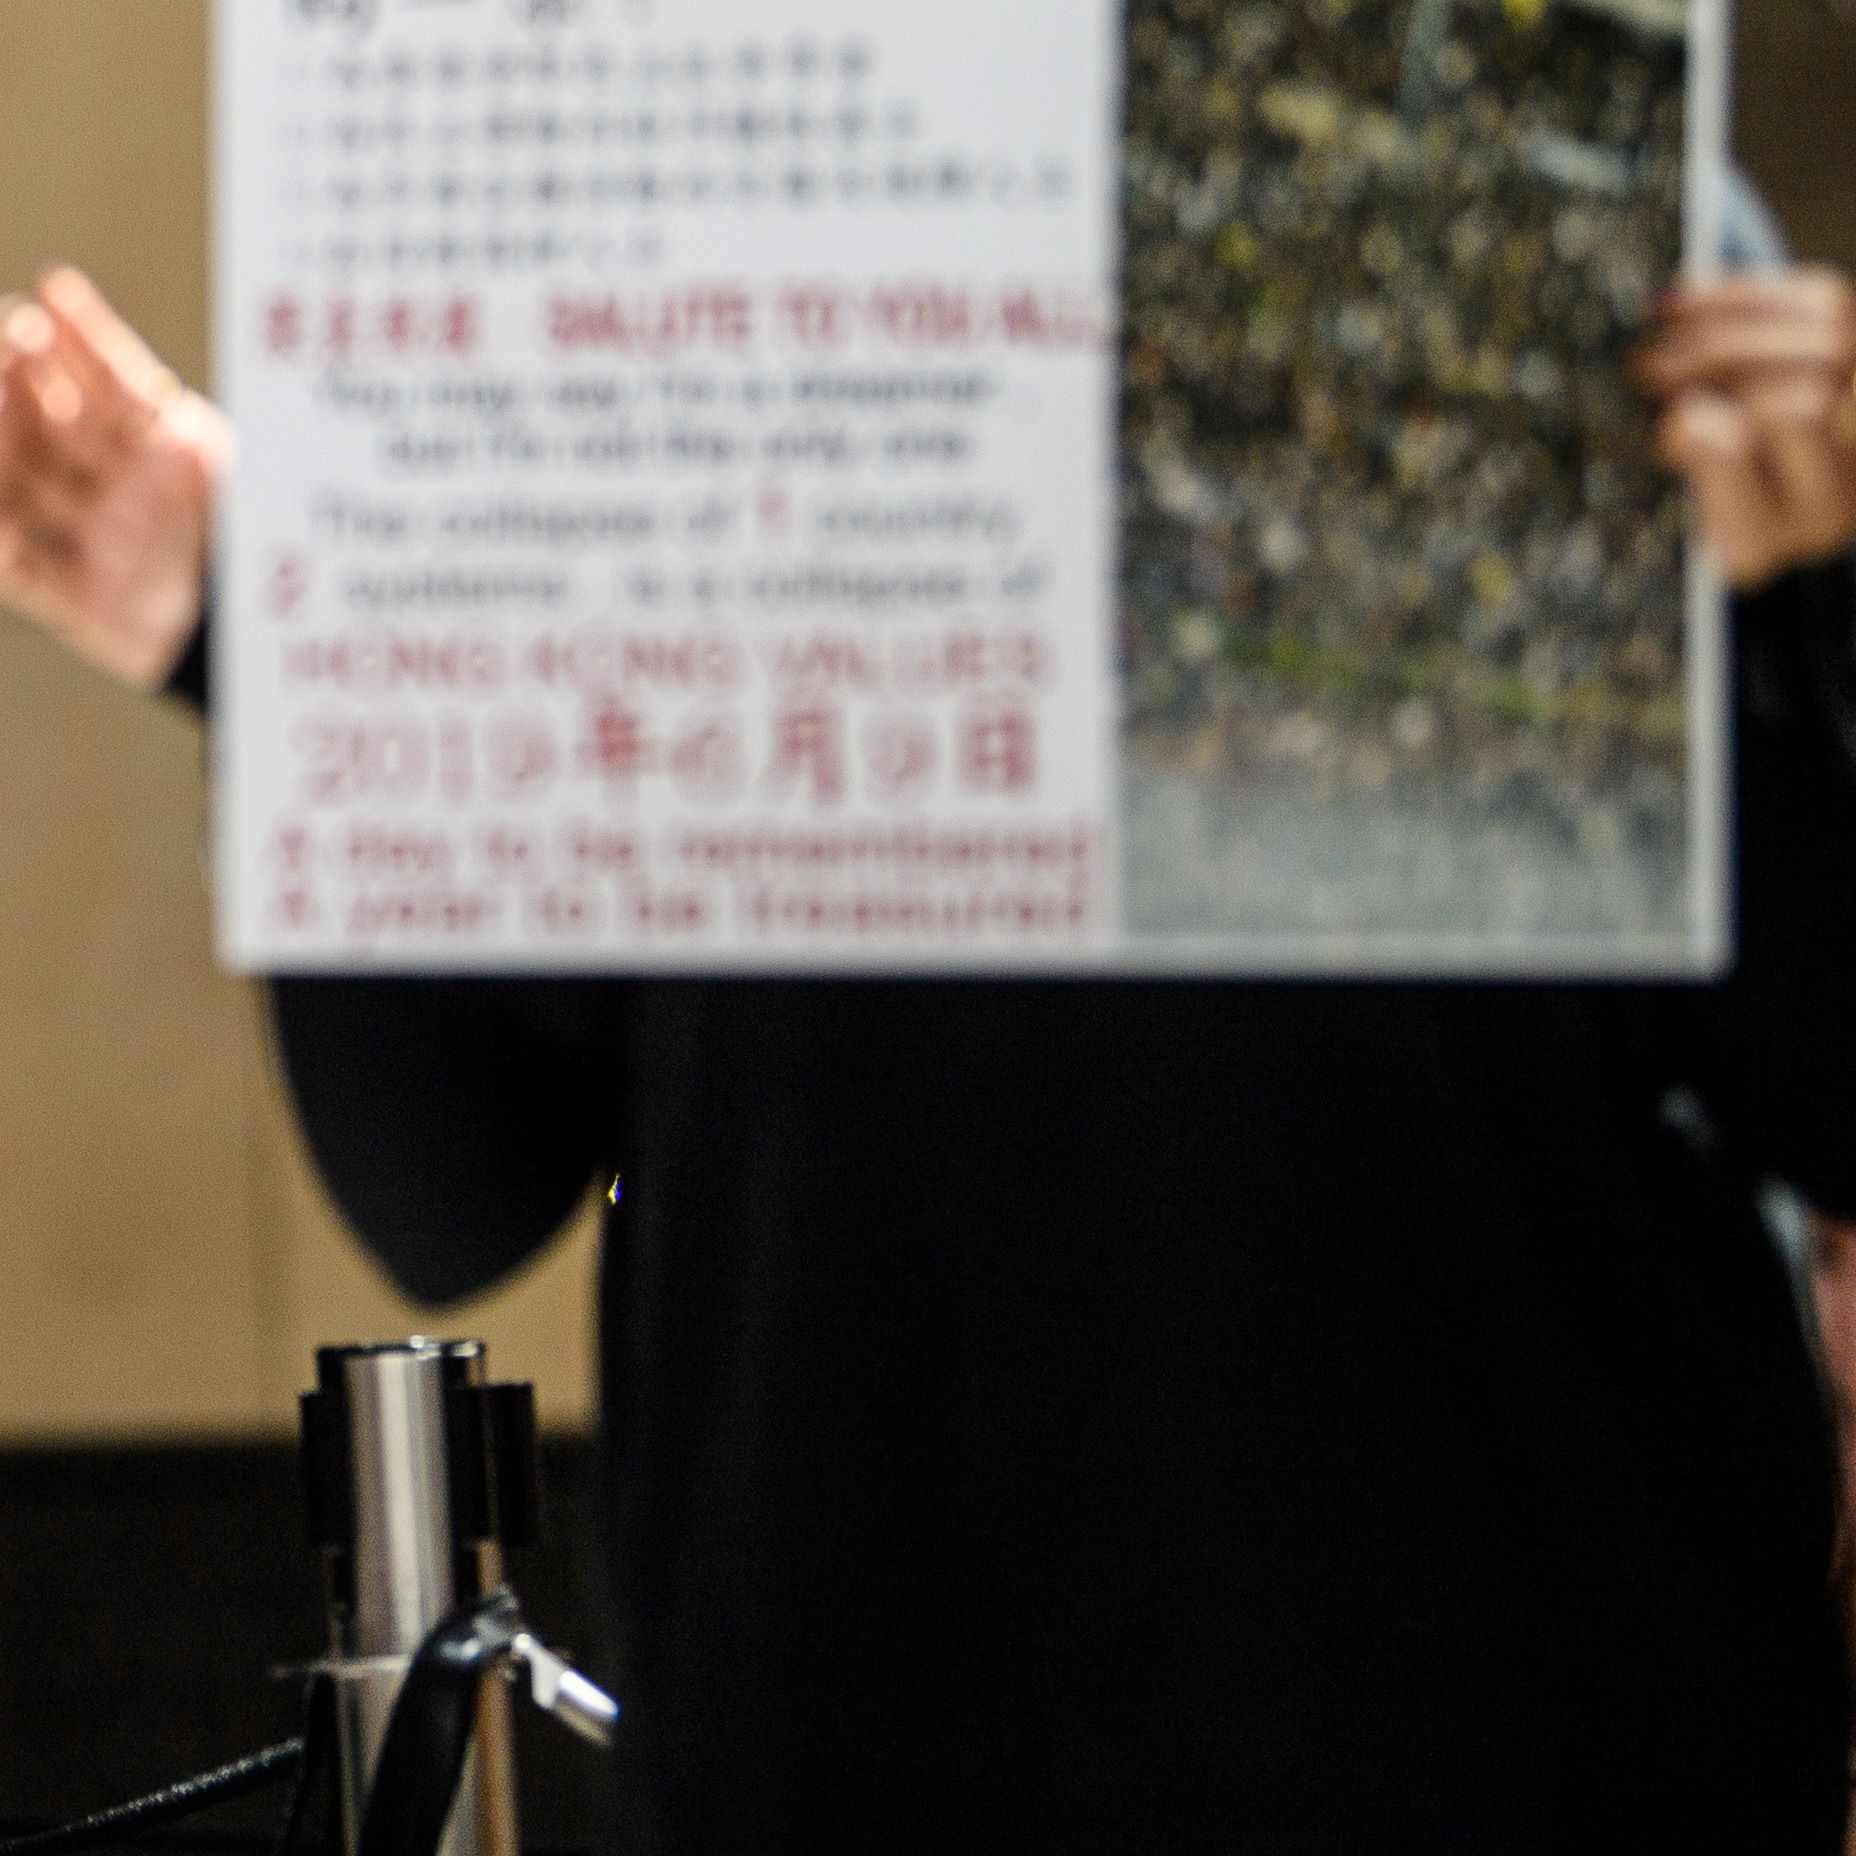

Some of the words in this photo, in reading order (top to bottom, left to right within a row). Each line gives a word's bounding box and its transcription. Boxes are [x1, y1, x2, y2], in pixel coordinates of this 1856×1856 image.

[288, 629, 509, 697] HONG
[525, 626, 744, 695] KONG
[762, 622, 1057, 693] VALUES
